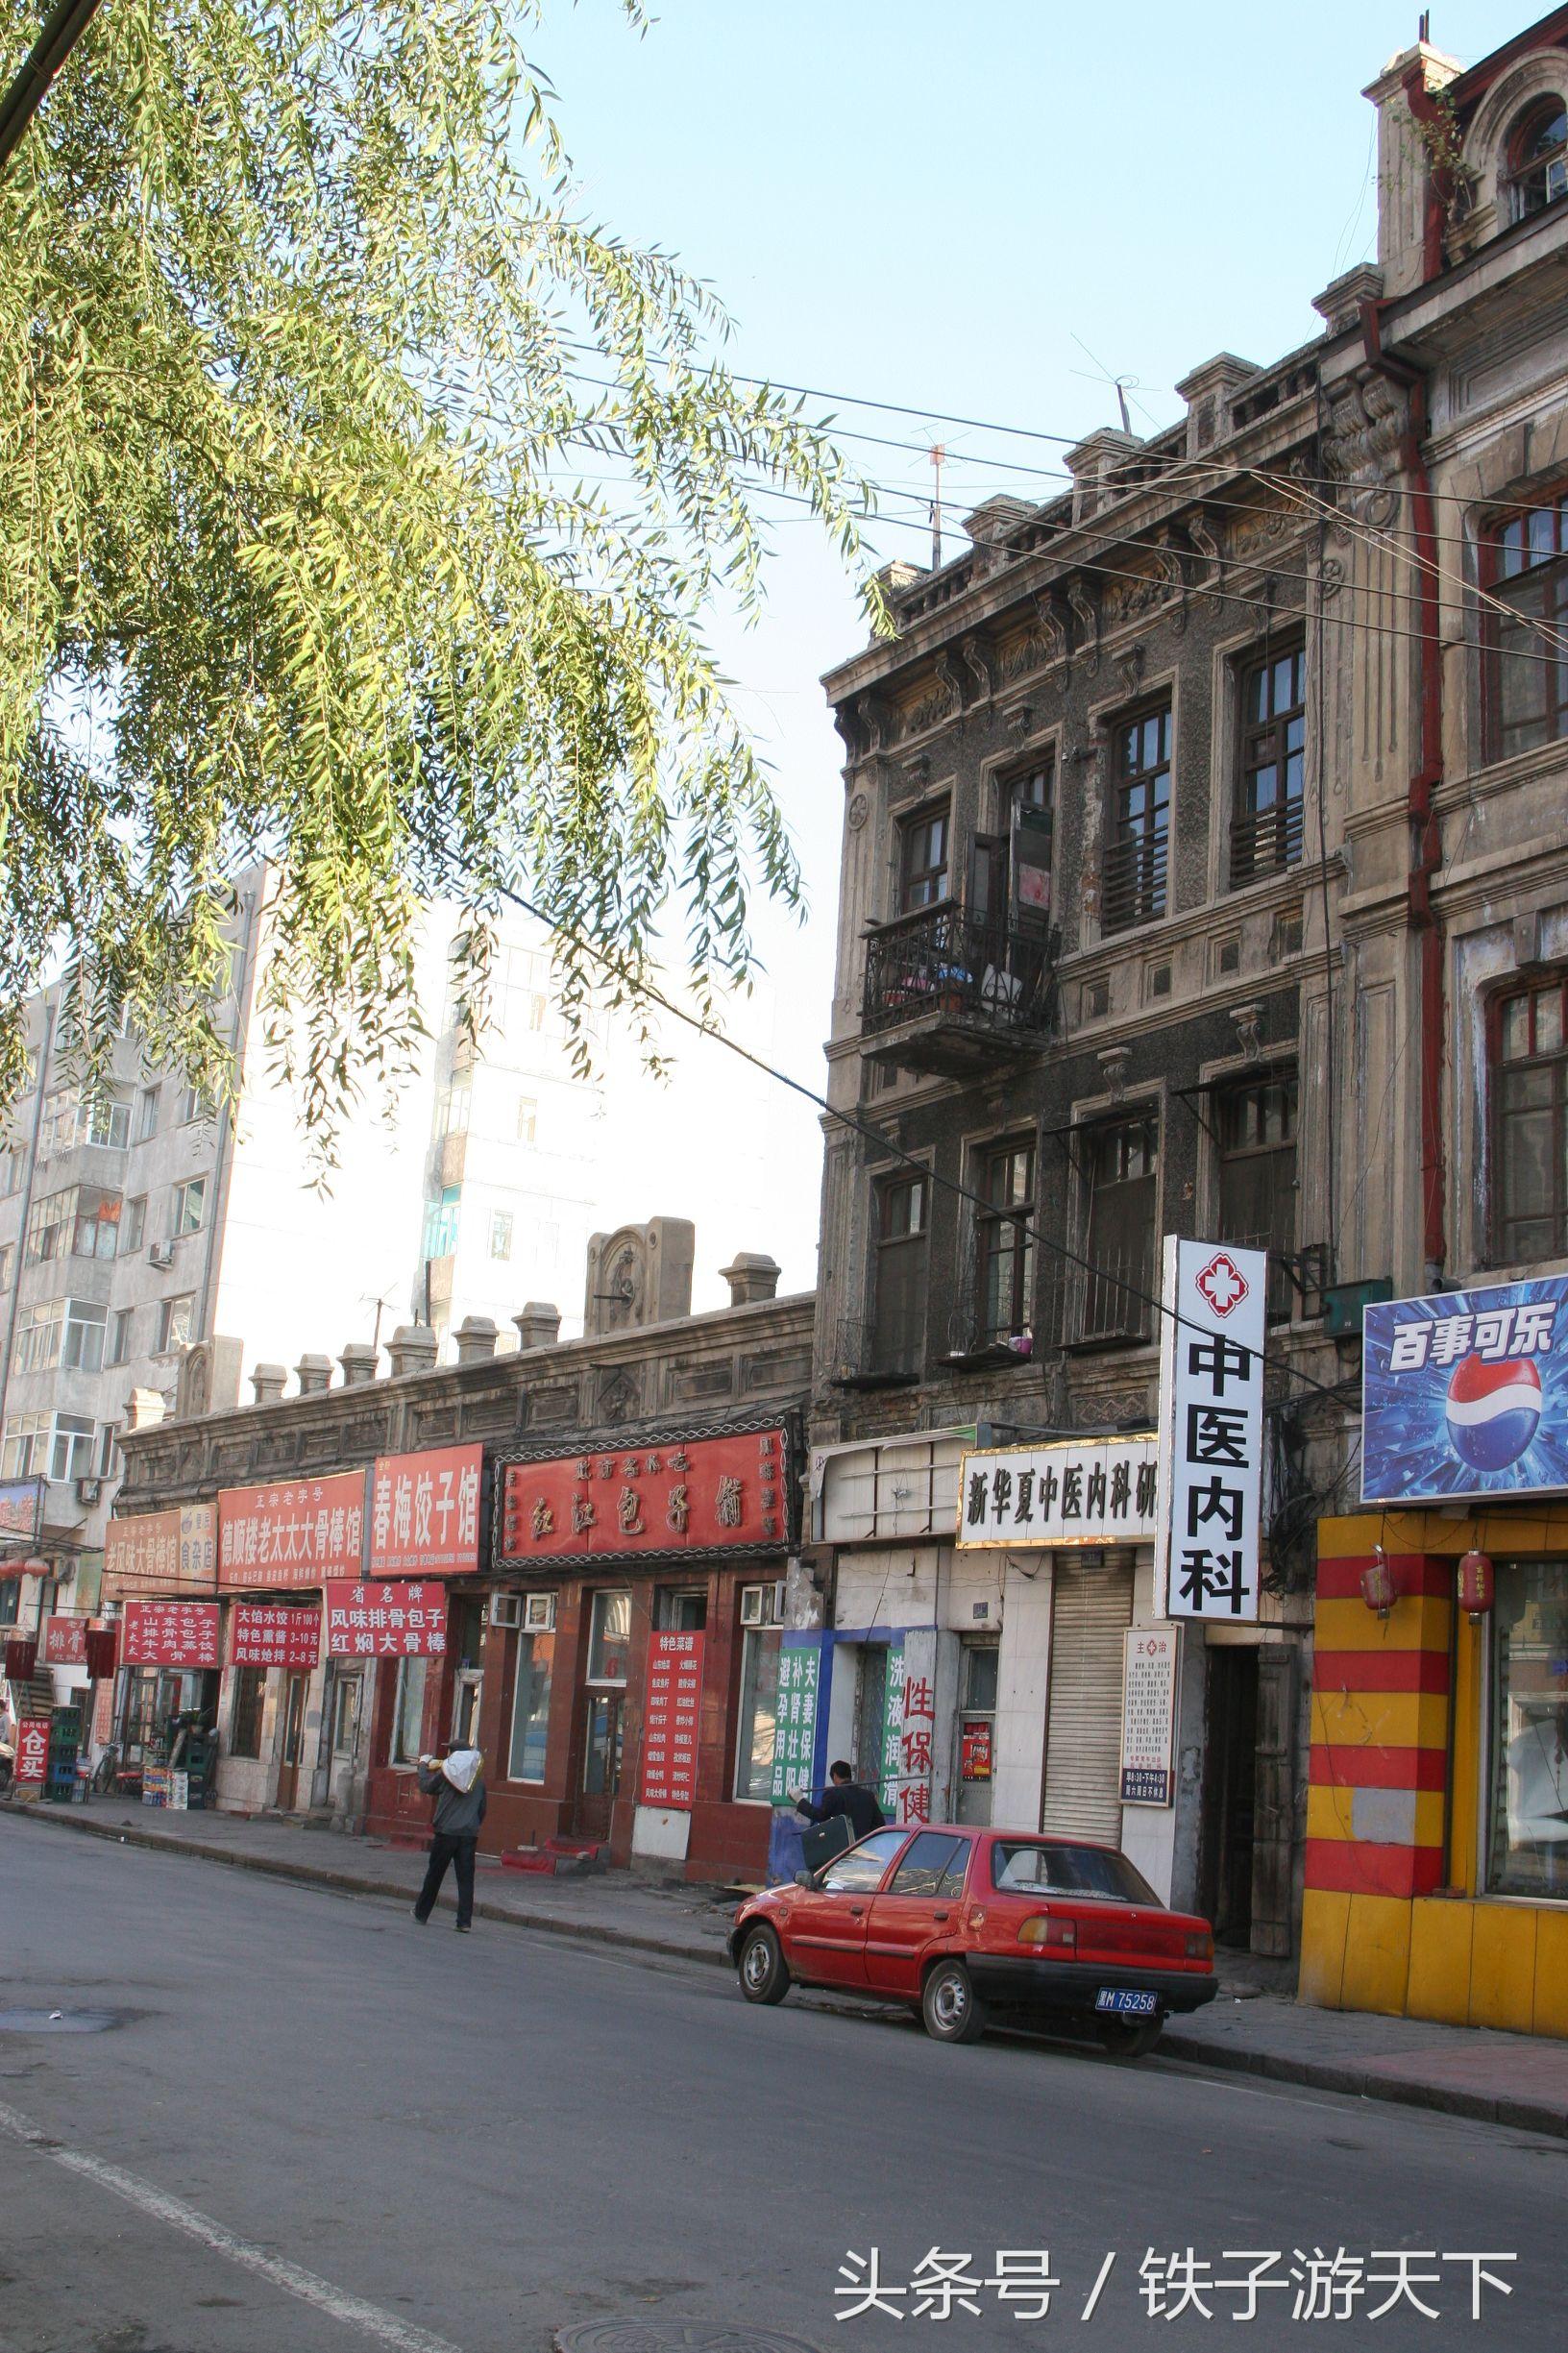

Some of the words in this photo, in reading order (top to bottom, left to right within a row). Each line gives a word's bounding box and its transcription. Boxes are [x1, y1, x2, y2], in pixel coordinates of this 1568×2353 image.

[1389, 1302, 1556, 1371] 百事可乐
[1179, 1334, 1250, 1615] 中医内科
[255, 1486, 324, 1508] 正宗老字号
[968, 1459, 1157, 1526] 新华夏中医内科研
[374, 1463, 478, 1550] 春梅饺子馆
[182, 1537, 212, 1570] 食杂店
[350, 1585, 424, 1604] 省名牌
[140, 1605, 206, 1615] 正宗老字号
[238, 1609, 289, 1627] 大馅水饺
[331, 1608, 445, 1630] 风味排骨包子
[142, 1628, 215, 1640] 排骨包子
[143, 1617, 215, 1629] 山东包子
[128, 1620, 138, 1655] 老太太
[142, 1639, 214, 1651] 牛肉蒸饺
[331, 1632, 446, 1653] 红焖大骨棒
[660, 1635, 694, 1652] 特色菜谱
[141, 1651, 214, 1663] 大骨棒
[772, 1655, 791, 1797] 避孕用品
[785, 1655, 803, 1792] 补肾壮阳
[21, 1729, 46, 1778] 仓买
[899, 1676, 936, 1825] 性保健
[1125, 1784, 1164, 1799] 周六周日不休息
[1118, 1992, 1155, 2010] 75258
